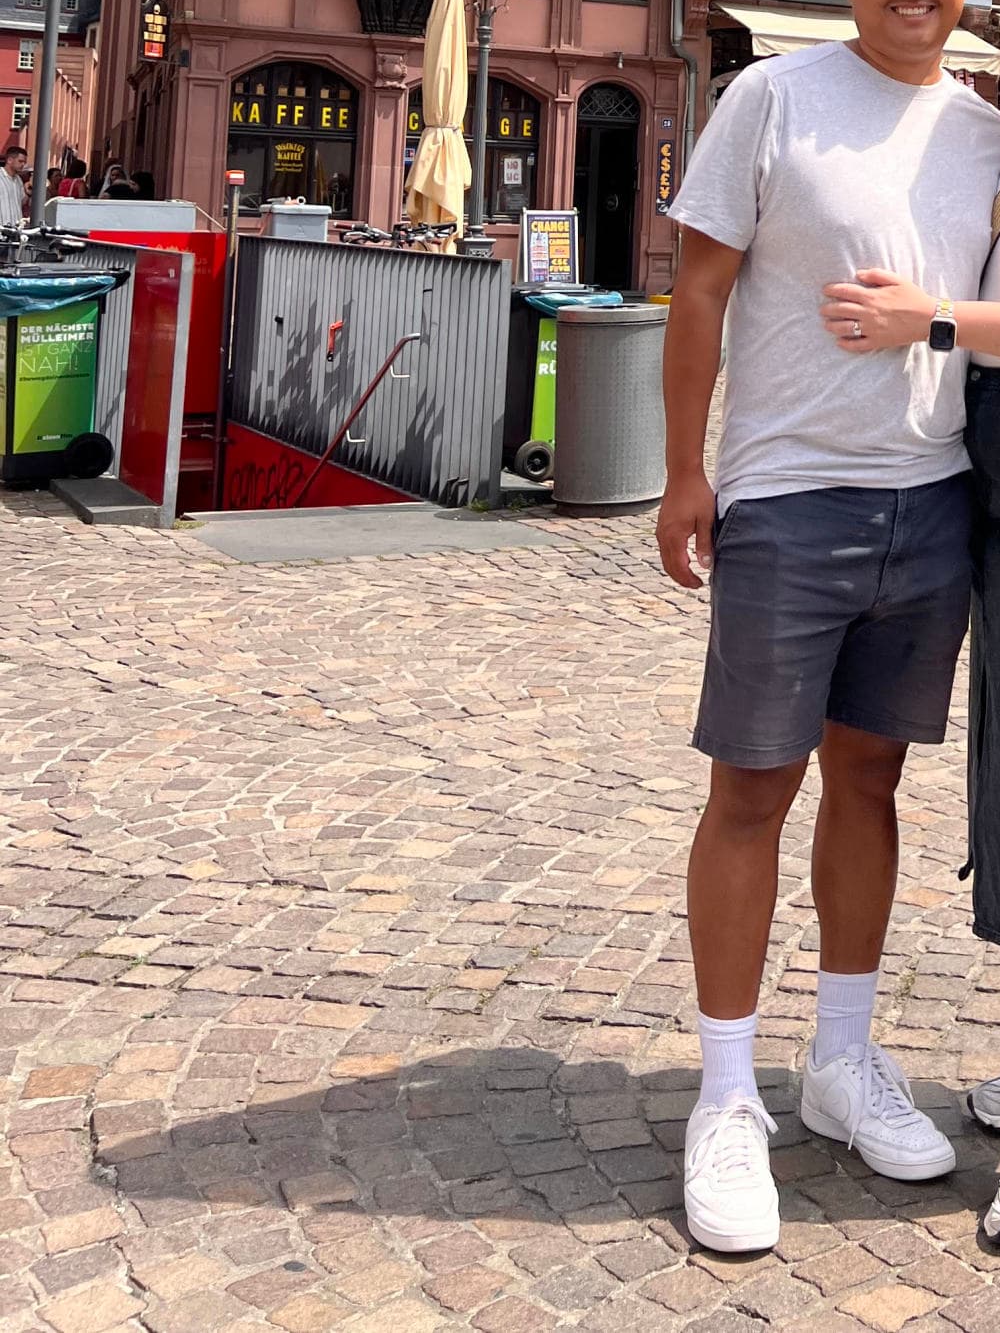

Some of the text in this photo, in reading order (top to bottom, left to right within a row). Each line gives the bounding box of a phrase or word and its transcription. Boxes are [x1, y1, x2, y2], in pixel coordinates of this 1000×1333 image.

[232, 101, 349, 128] KAFFEE
[531, 221, 570, 233] CHANGE
[46, 322, 94, 333] NÄCHSTE
[21, 332, 95, 344] MÜLLEIMER
[48, 340, 93, 355] GANZ
[19, 355, 78, 374] NAH!
